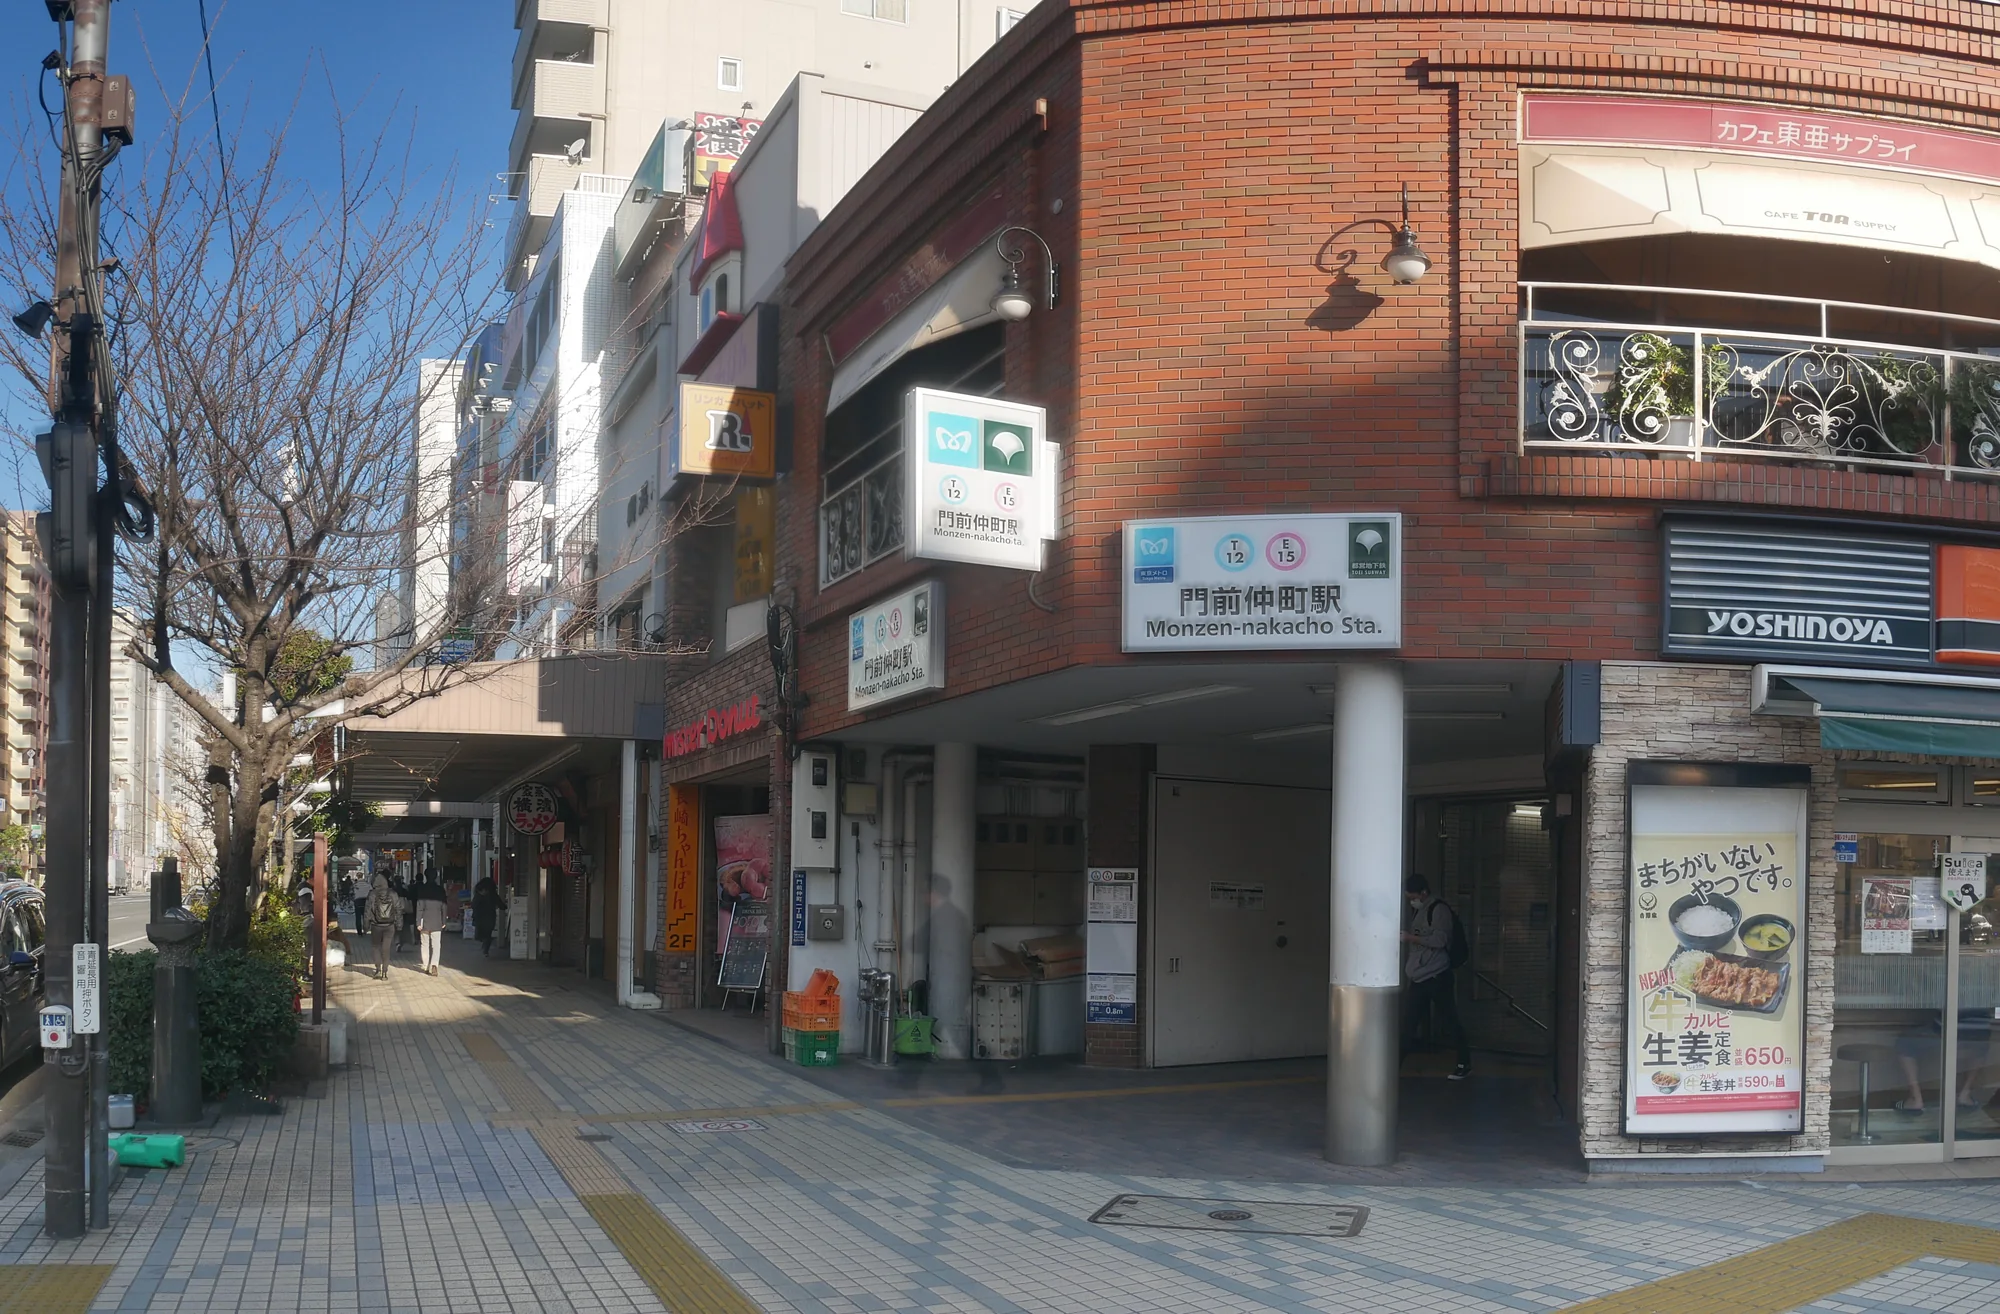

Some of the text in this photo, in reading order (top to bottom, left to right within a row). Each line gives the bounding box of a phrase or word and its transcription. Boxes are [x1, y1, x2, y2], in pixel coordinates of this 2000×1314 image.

[1717, 119, 1917, 162] カフェ東亜サプライ
[1764, 210, 1897, 231] CAFE TOA SUPPLY
[948, 488, 961, 499] 12
[951, 480, 956, 488] T
[1006, 487, 1011, 496] E
[1002, 496, 1015, 507] 15
[1230, 540, 1238, 551] T
[1282, 539, 1290, 550] E
[1226, 552, 1244, 564] 12
[1277, 551, 1295, 563] 15
[1179, 585, 1342, 616] 門前仲町駅
[1146, 616, 1382, 638] Monzen-nakacho Sta.
[1707, 610, 1893, 644] YOSHINOYA
[864, 643, 913, 682] 門前仲町駅
[855, 666, 925, 700] Monzen-nakacho Sta.
[515, 812, 556, 832] ラーメン
[673, 789, 692, 911] 長崎ちゃんぽん
[1637, 843, 1775, 888] まちがいない
[1944, 857, 1983, 868] Suica
[1690, 863, 1793, 904] やつです。
[796, 920, 802, 929] 7
[669, 933, 693, 949] 2F
[87, 950, 96, 989] 青延長用
[1639, 967, 1676, 991] NEW!
[82, 989, 91, 1028] 押ボタン
[1105, 1006, 1124, 1015] 0.8m
[1684, 1010, 1734, 1030] カルビ
[1744, 1046, 1792, 1065] 650円
